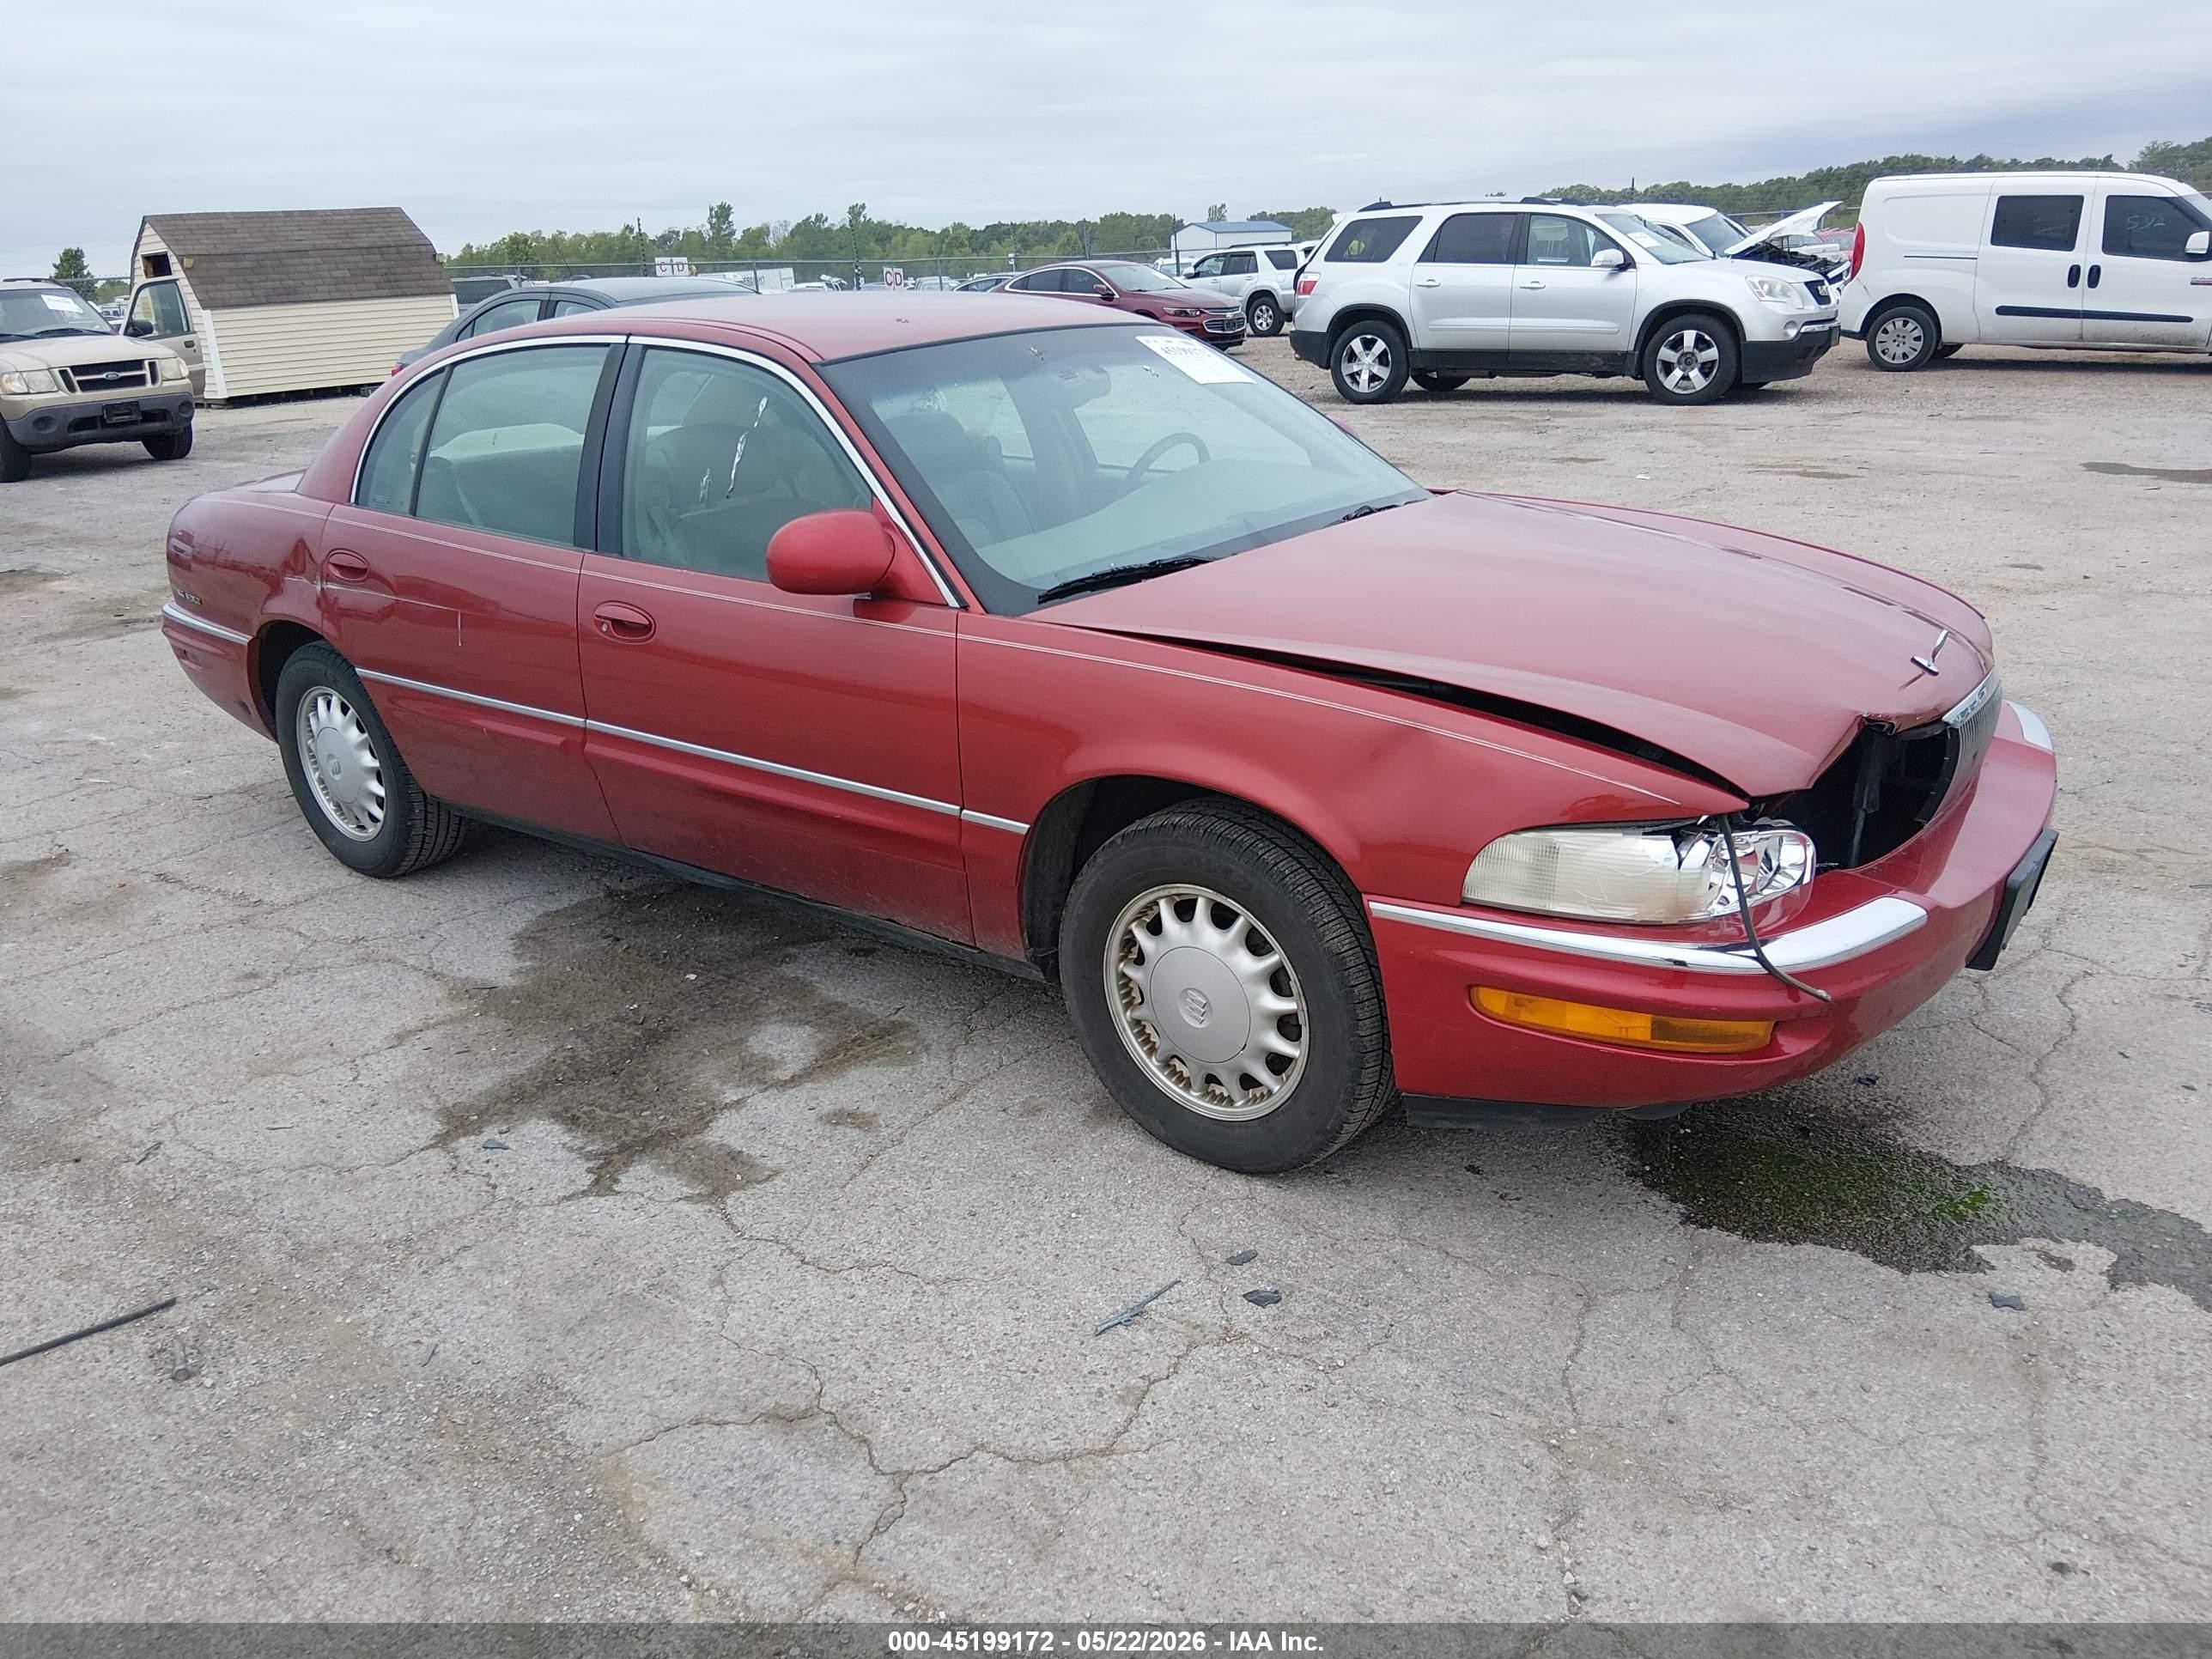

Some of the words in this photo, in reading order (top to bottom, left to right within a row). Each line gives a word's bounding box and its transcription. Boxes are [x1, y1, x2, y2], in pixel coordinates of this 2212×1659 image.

[659, 261, 667, 272] C
[677, 261, 684, 272] D
[885, 270, 893, 286] C
[895, 272, 902, 286] D
